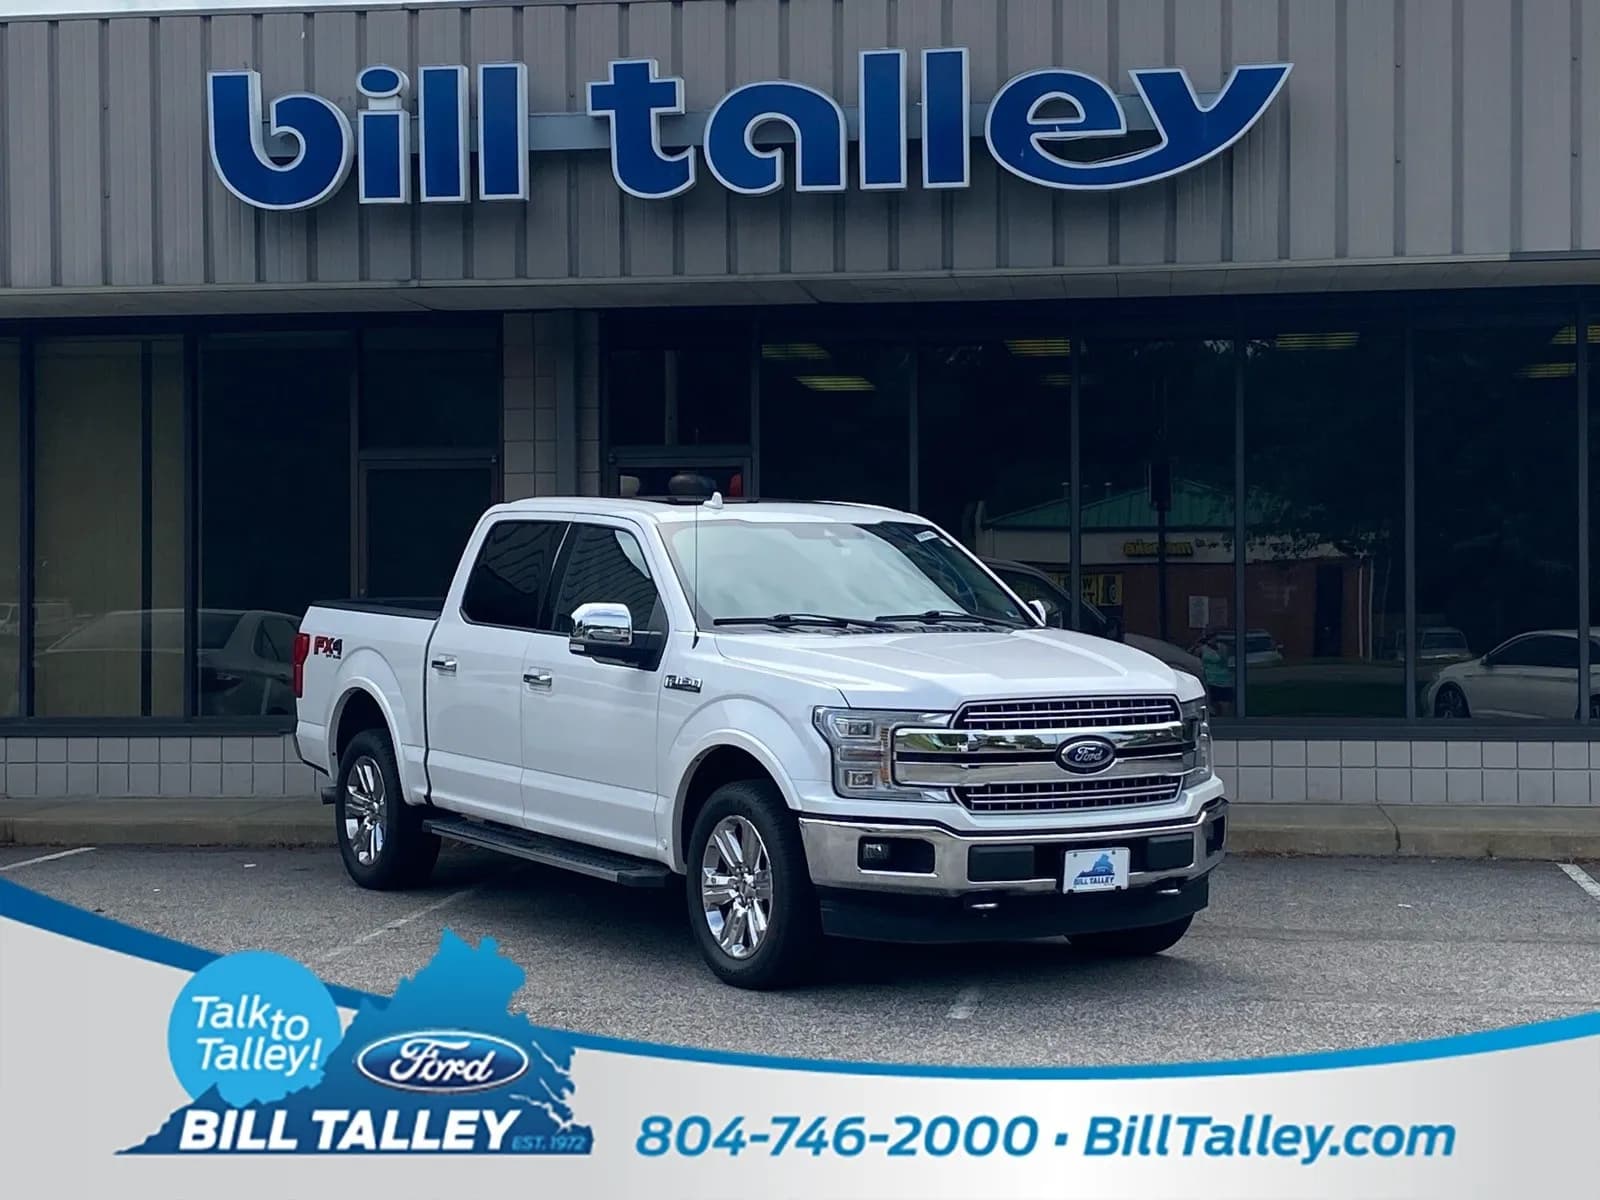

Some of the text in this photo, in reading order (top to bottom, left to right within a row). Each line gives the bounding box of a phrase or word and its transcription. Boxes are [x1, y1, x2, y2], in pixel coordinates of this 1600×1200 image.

[207, 47, 1293, 210] bill talley
[314, 636, 343, 655] FX4
[1075, 746, 1103, 761] Ford
